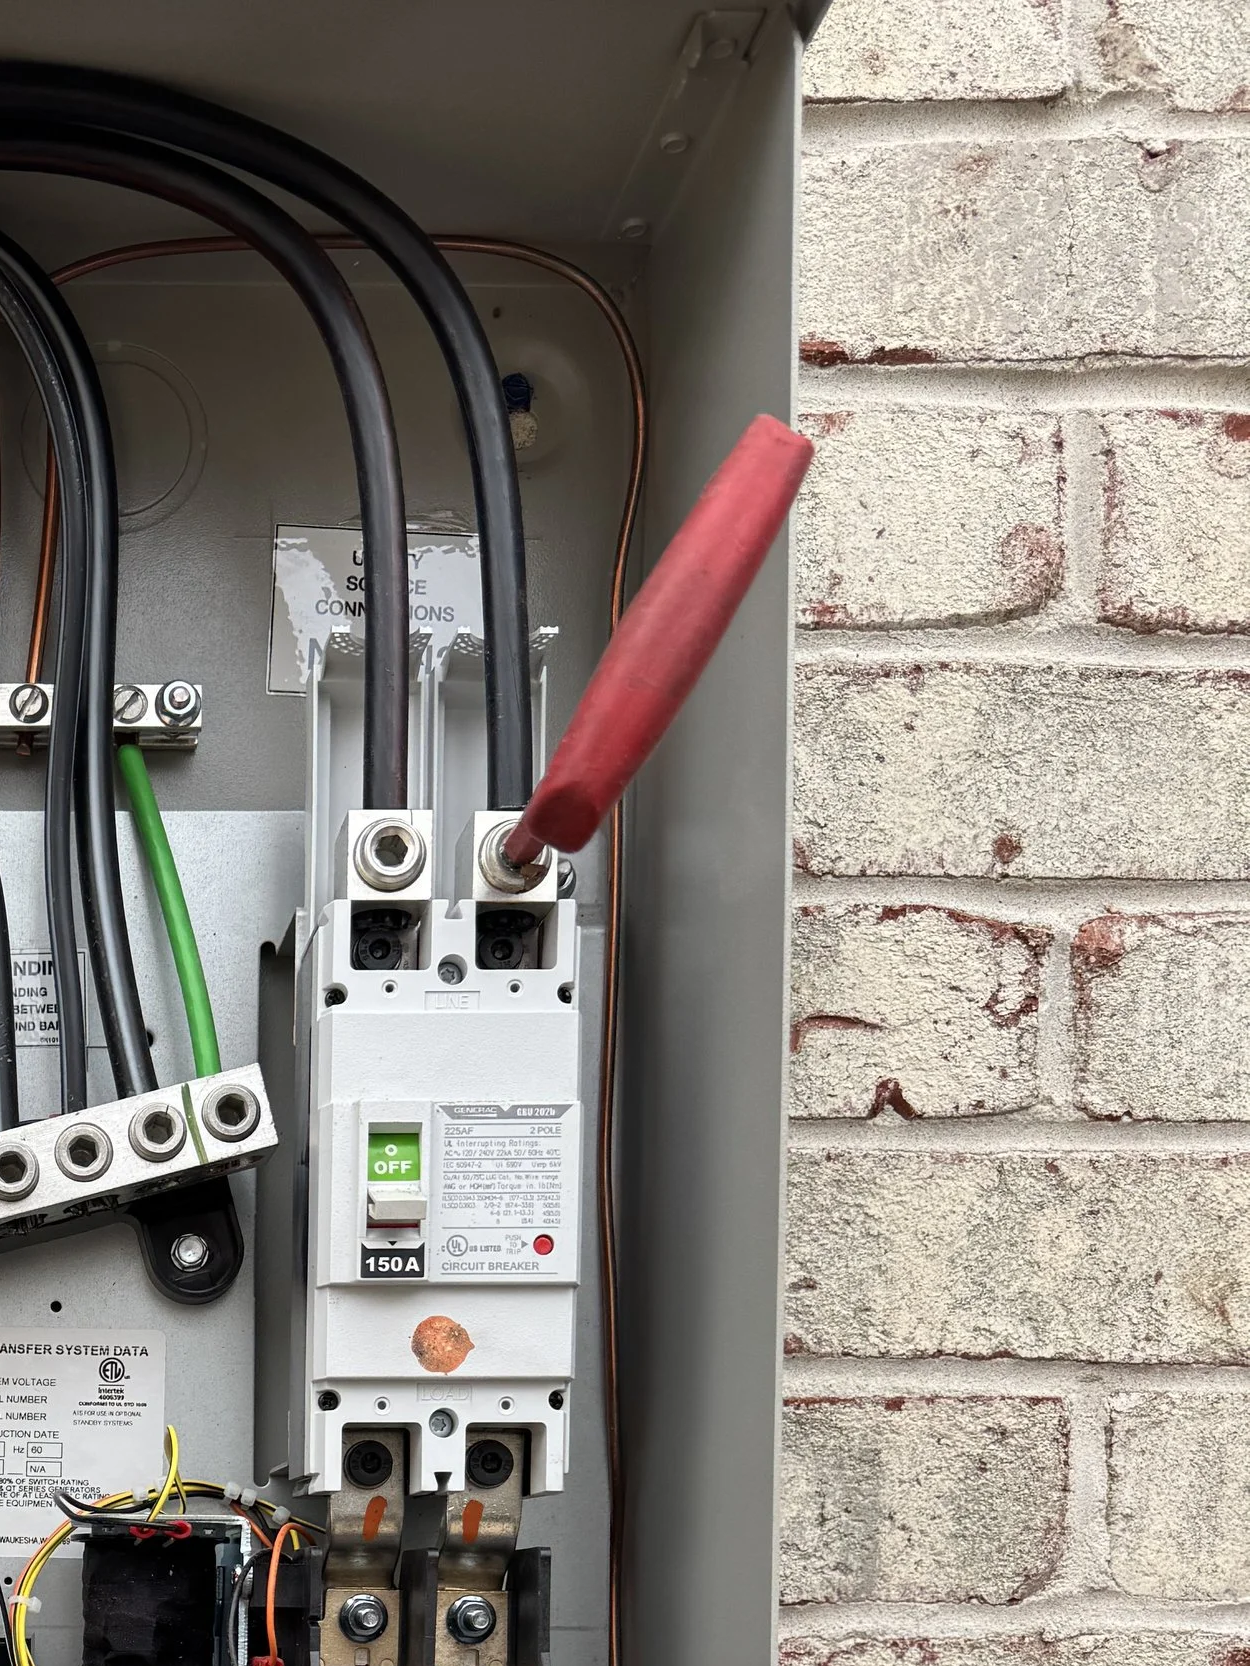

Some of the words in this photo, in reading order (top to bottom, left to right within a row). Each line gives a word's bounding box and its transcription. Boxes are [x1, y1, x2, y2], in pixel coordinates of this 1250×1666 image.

[445, 1127, 473, 1135] 225AF
[374, 1161, 412, 1175] OFF
[366, 1257, 420, 1272] 150A
[442, 1262, 486, 1271] CIRCUIT
[489, 1262, 539, 1270] BREAKER
[56, 1345, 109, 1355] SYSTEM
[113, 1346, 149, 1357] DATA
[12, 1378, 56, 1386] VOLTAGE
[421, 1385, 470, 1400] LOAD
[7, 1396, 47, 1404] NUMBER
[34, 1431, 59, 1439] DATE
